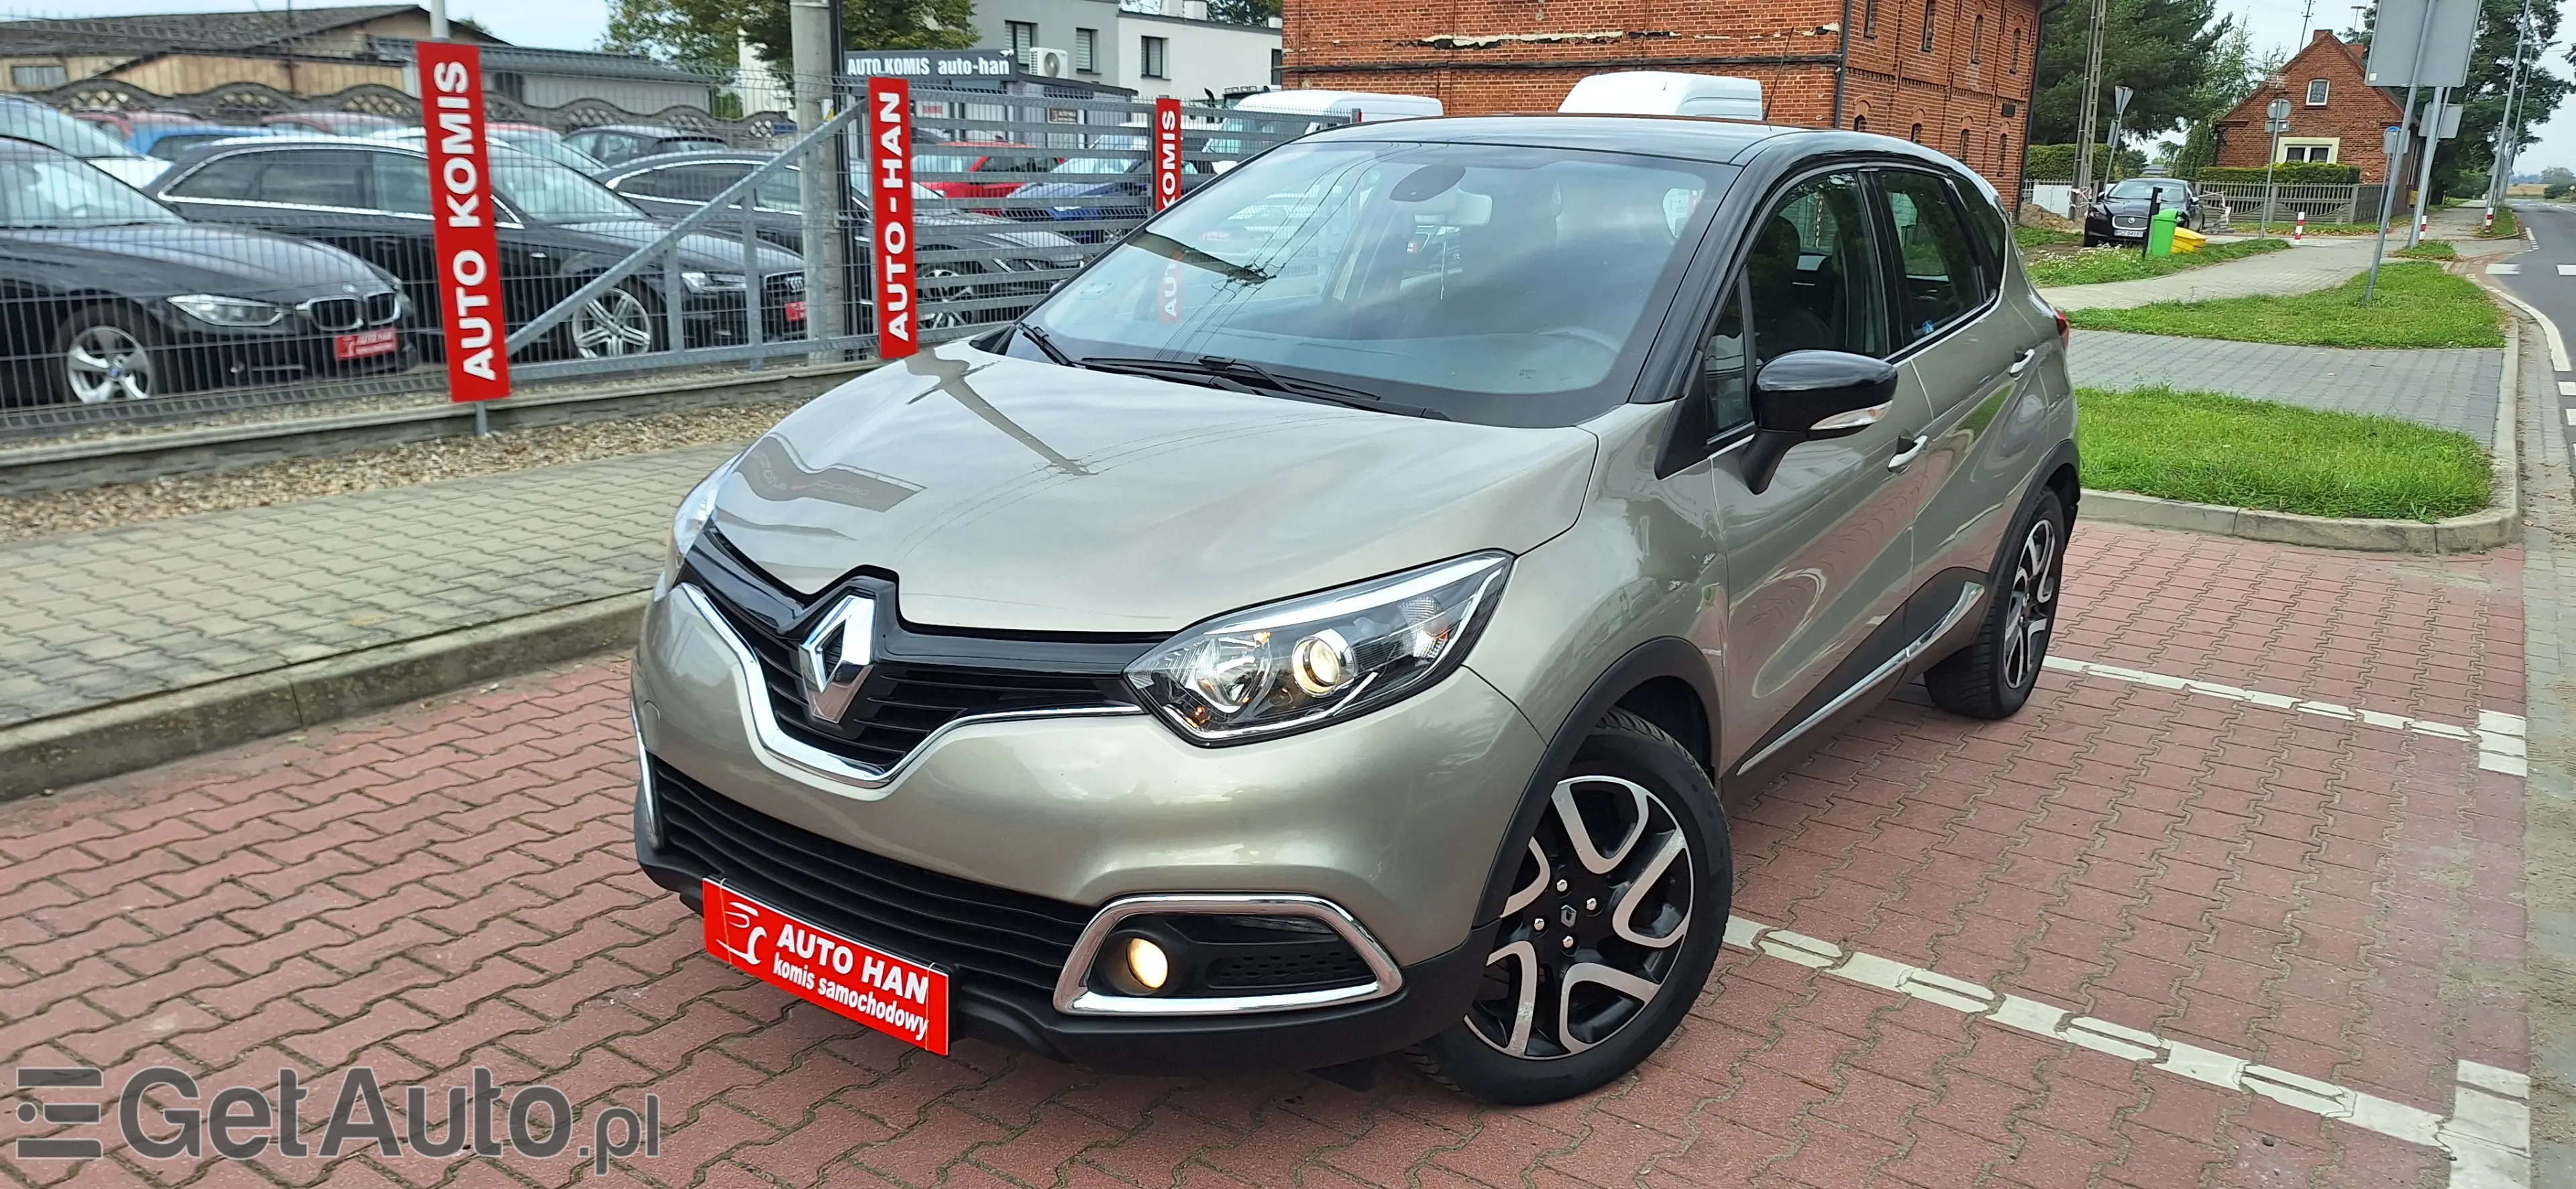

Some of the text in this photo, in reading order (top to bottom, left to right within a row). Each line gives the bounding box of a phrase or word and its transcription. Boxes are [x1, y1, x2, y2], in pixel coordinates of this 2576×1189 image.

[847, 57, 1010, 75] AUTO KOMIS auto-han
[433, 61, 496, 380] AUTO KOMIS
[773, 952, 930, 1042] komis samochodowy
[776, 923, 928, 1005] AUTO HAN
